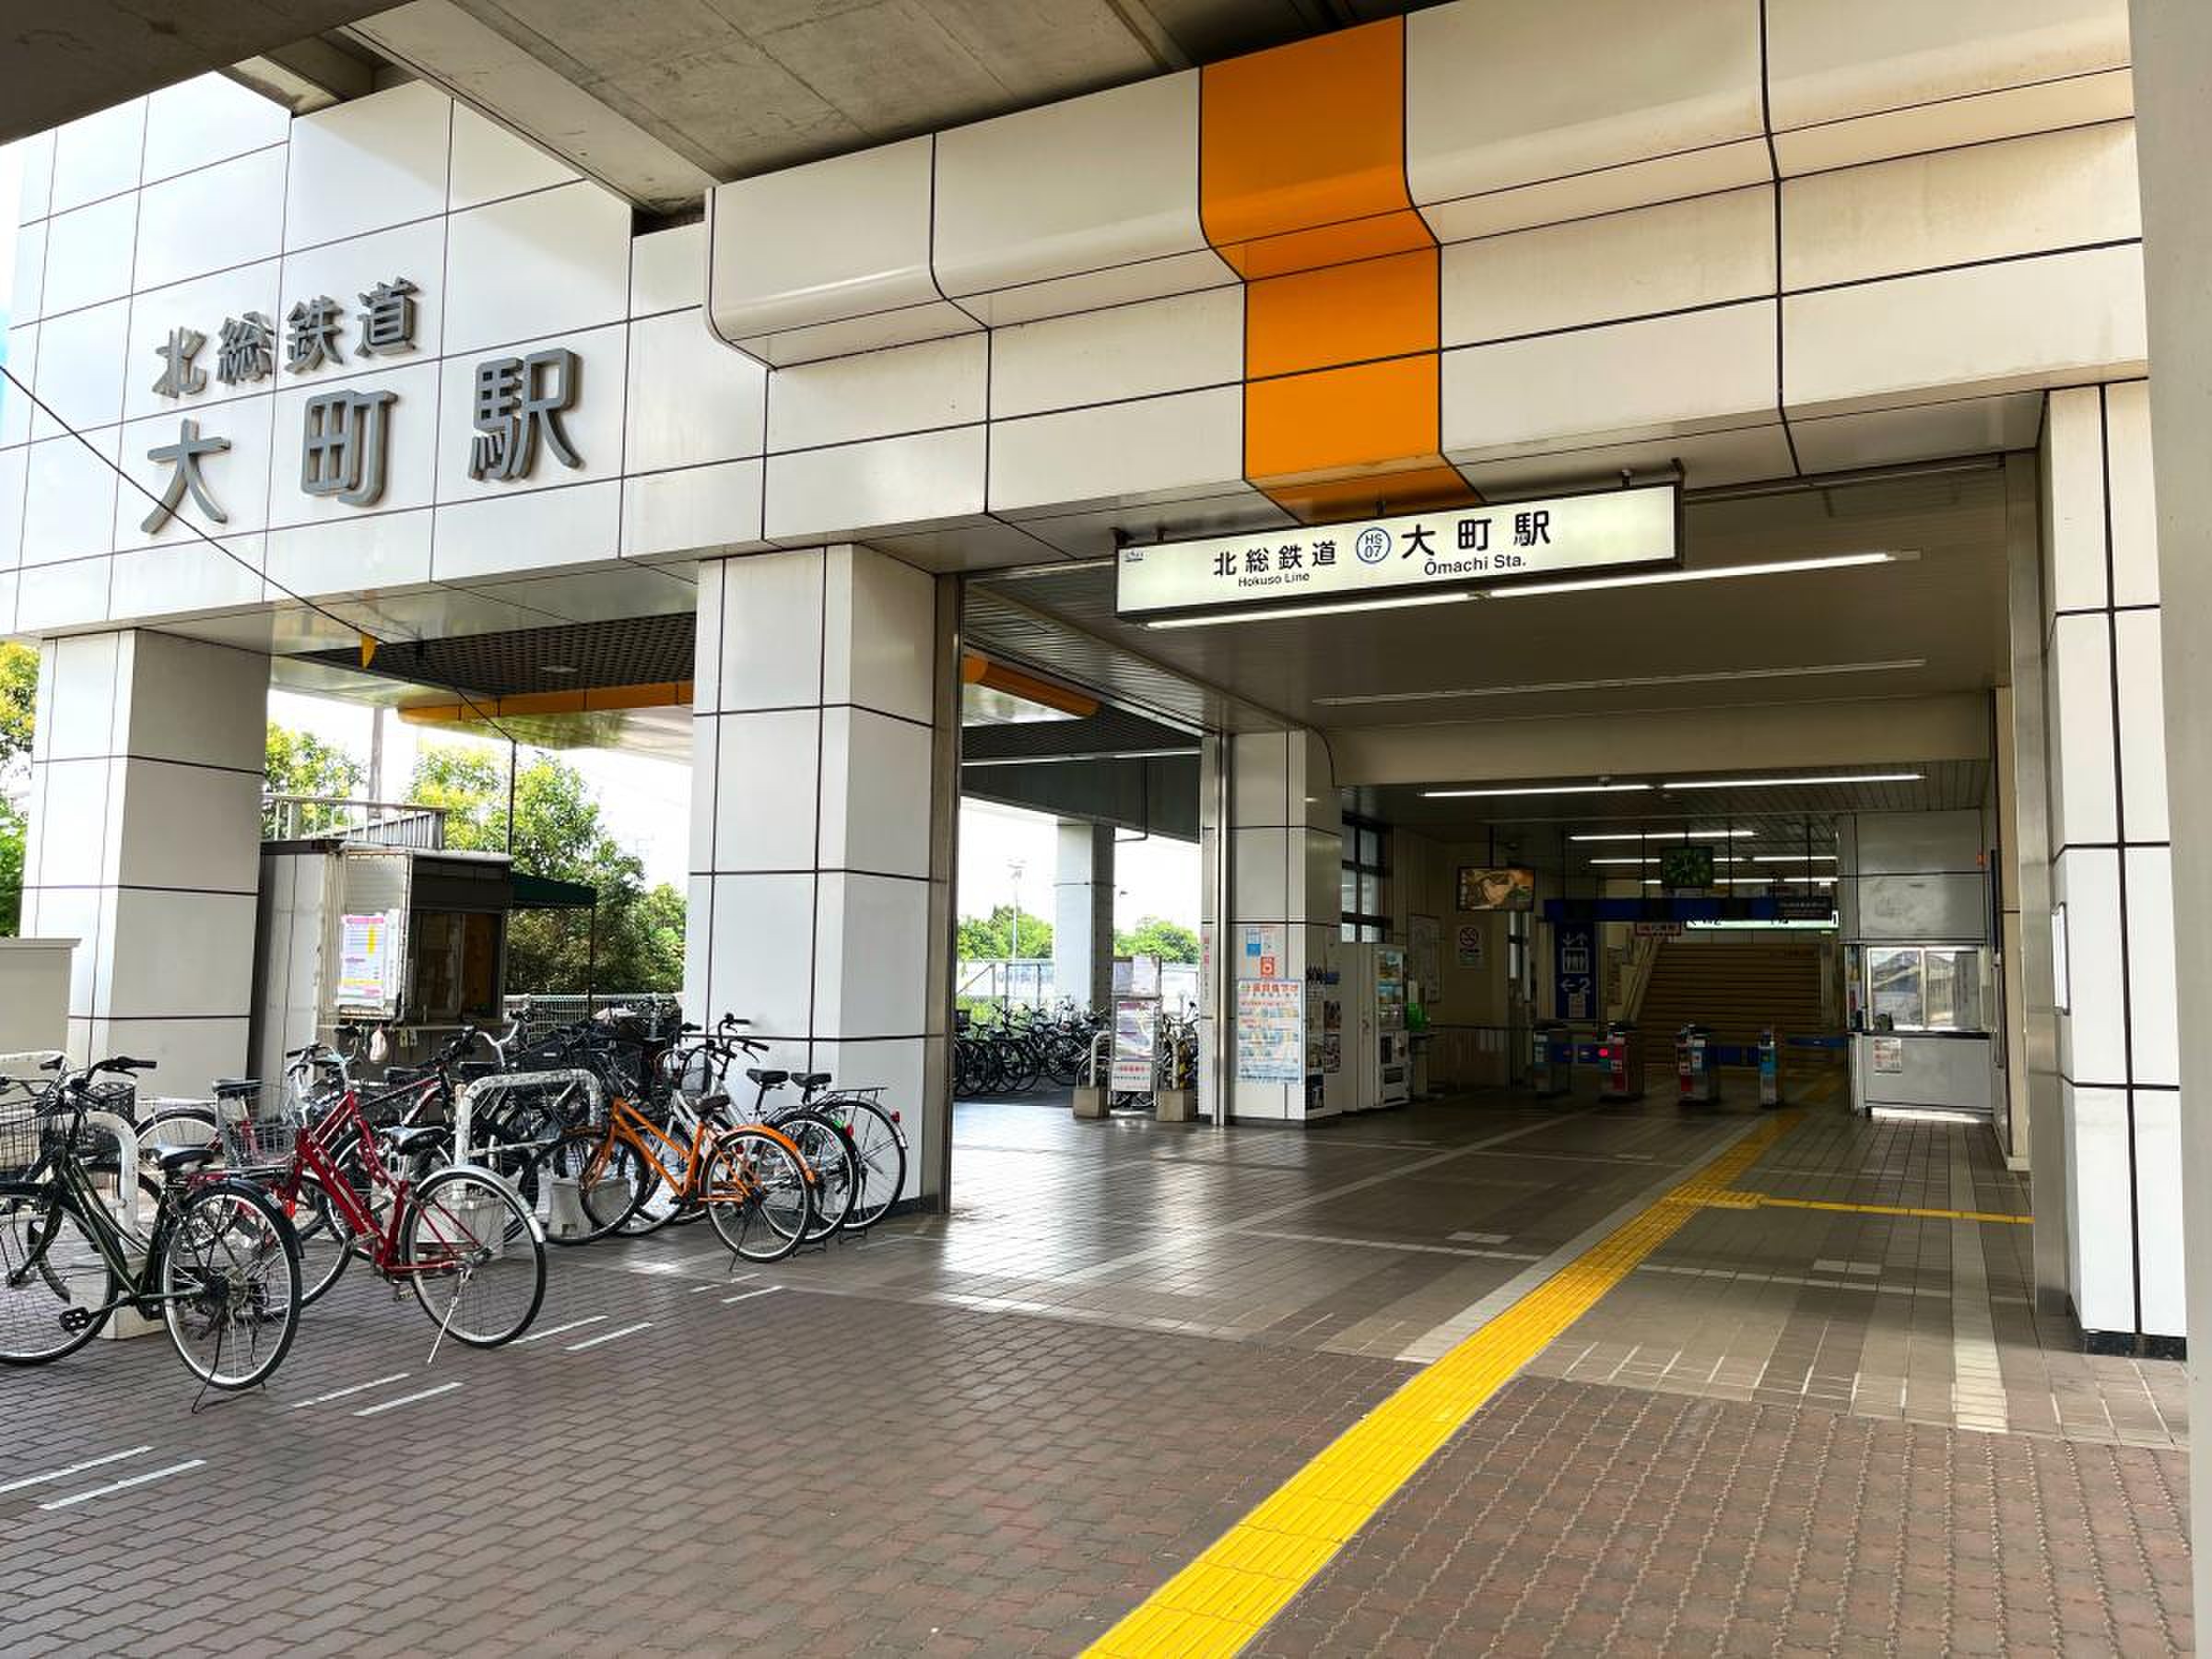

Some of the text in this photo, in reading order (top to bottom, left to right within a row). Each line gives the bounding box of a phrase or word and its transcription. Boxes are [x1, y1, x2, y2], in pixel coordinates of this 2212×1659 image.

[152, 276, 419, 398] 北総鉄道
[141, 347, 584, 533] 大町駅
[1365, 534, 1382, 546] HS
[1401, 511, 1550, 559] 大町駅
[1214, 540, 1336, 576] 北総鉄道
[1364, 545, 1382, 559] 07
[1494, 553, 1527, 569] Sta.
[1238, 571, 1310, 588] Hokuso Line
